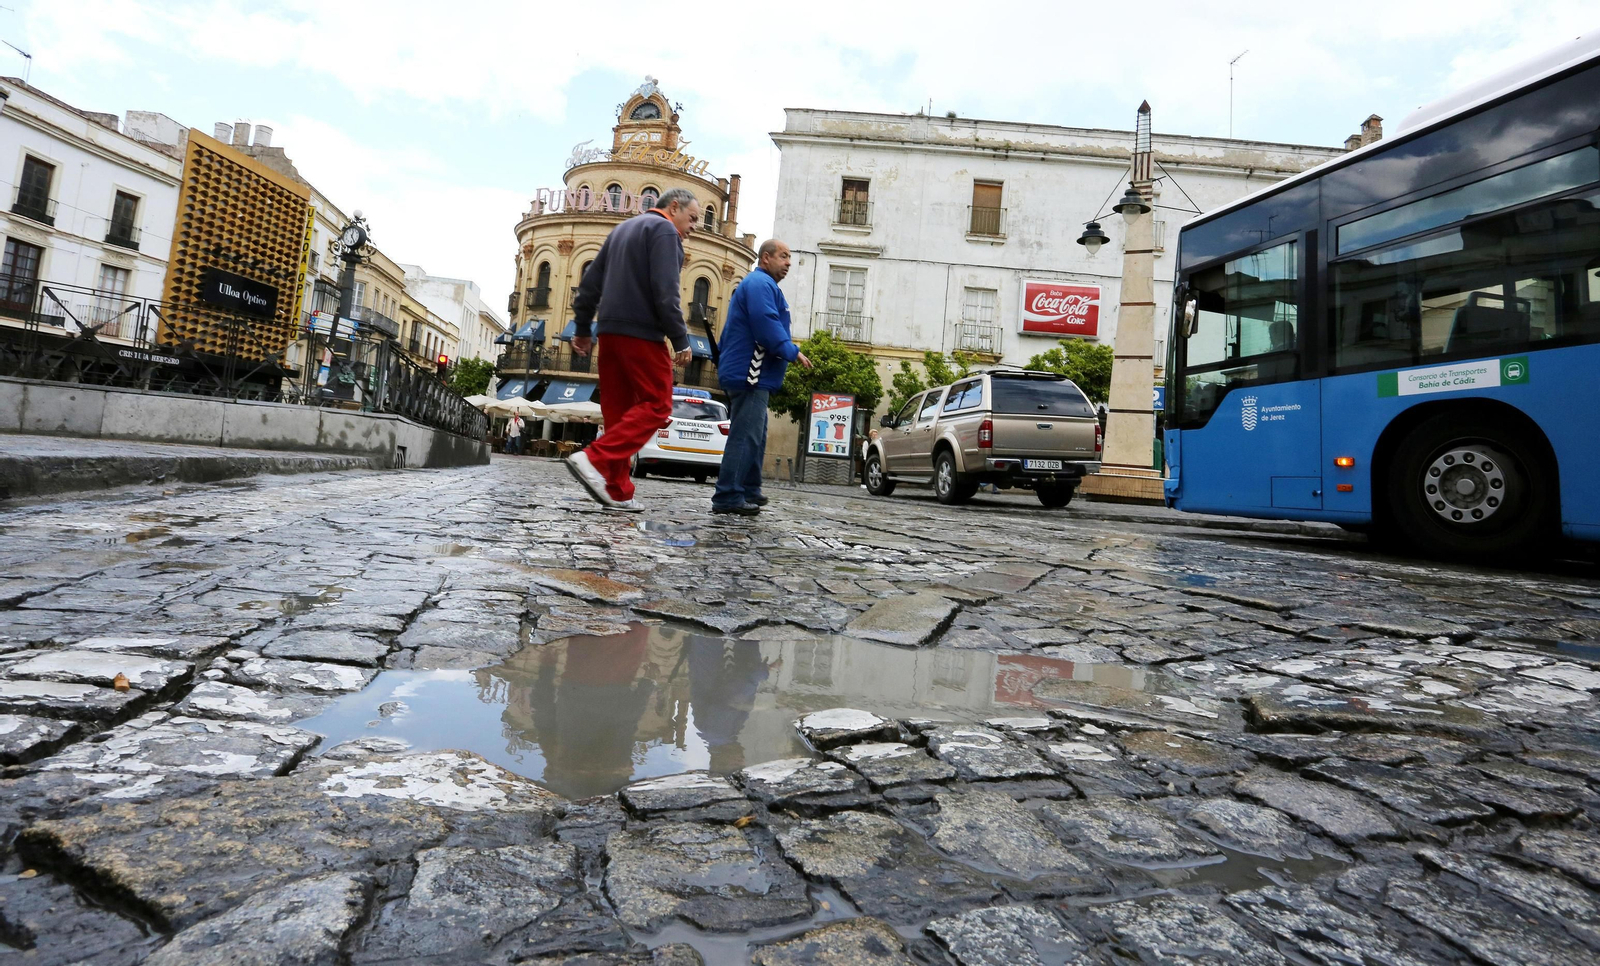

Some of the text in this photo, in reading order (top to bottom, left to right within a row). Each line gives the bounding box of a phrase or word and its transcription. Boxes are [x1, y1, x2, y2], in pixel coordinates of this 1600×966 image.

[610, 129, 651, 162] La
[536, 187, 660, 214] FUNDADO
[290, 208, 315, 339] ULLOA OPTICO
[218, 282, 267, 306] Ulloa Optico
[1032, 292, 1091, 316] Coca-Cola
[1067, 315, 1086, 325] Coke
[1408, 367, 1488, 382] Consorcio de Transportes
[1418, 377, 1476, 389] Bahía de Cádiz
[813, 396, 838, 410] 3x2
[1261, 404, 1302, 413] Ayuntamiento
[1029, 460, 1046, 468] 7132
